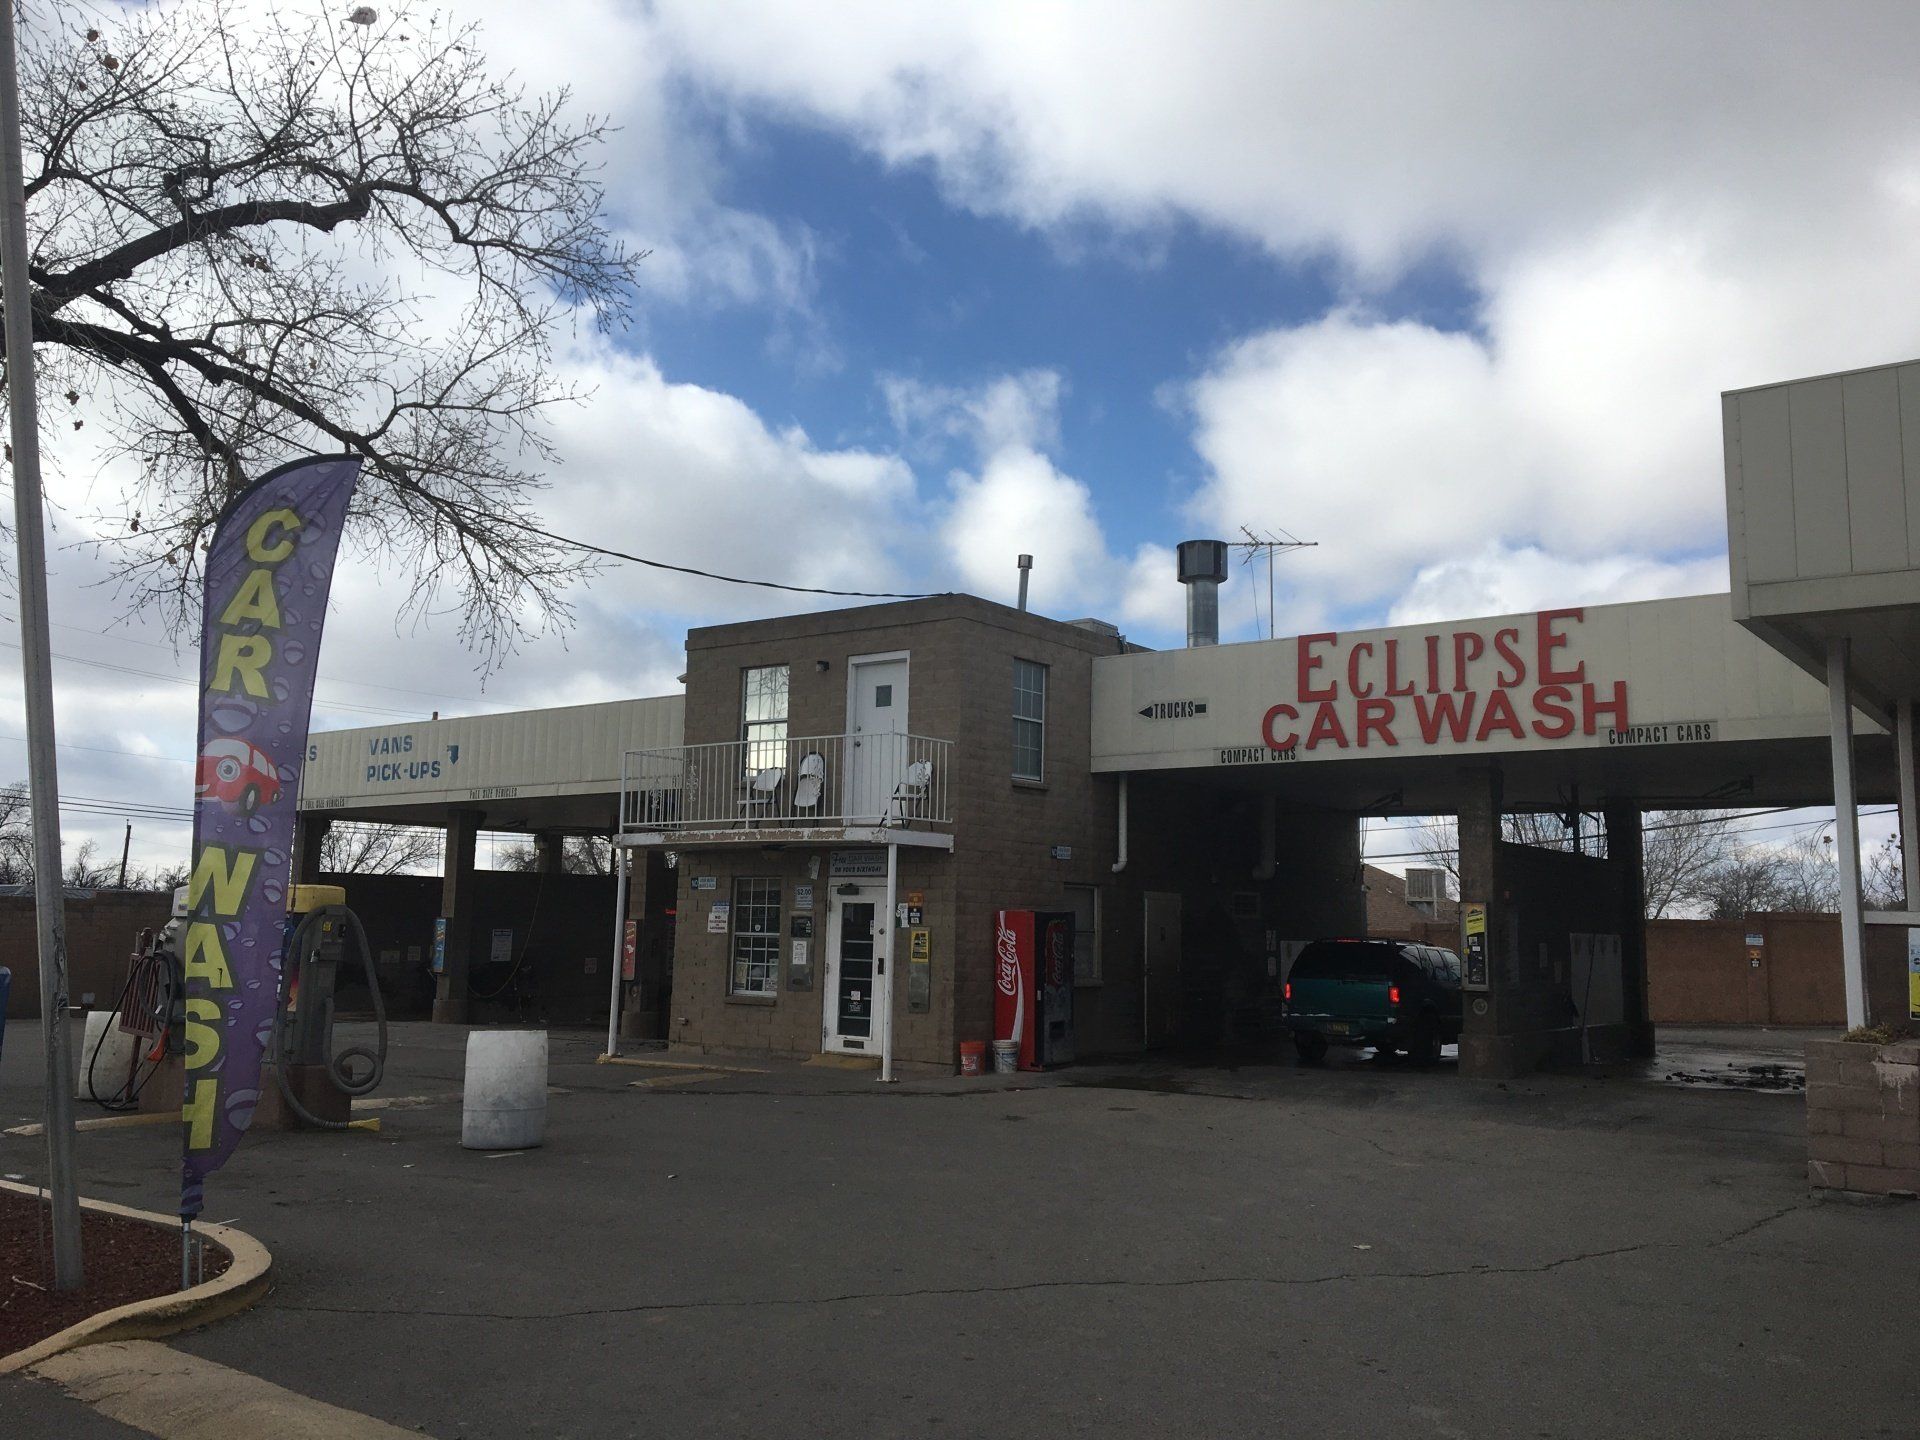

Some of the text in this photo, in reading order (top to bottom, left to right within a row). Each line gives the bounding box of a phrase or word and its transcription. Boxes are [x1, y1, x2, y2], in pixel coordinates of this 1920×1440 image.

[210, 507, 301, 699] CAR
[1297, 607, 1586, 703] ECLIPSE
[1153, 701, 1195, 720] TRUCKS
[1609, 723, 1712, 745] COMPACT CARS
[368, 735, 413, 756] VANS
[1220, 747, 1296, 764] COMPACT CARS
[366, 760, 442, 782] PICK-UPS
